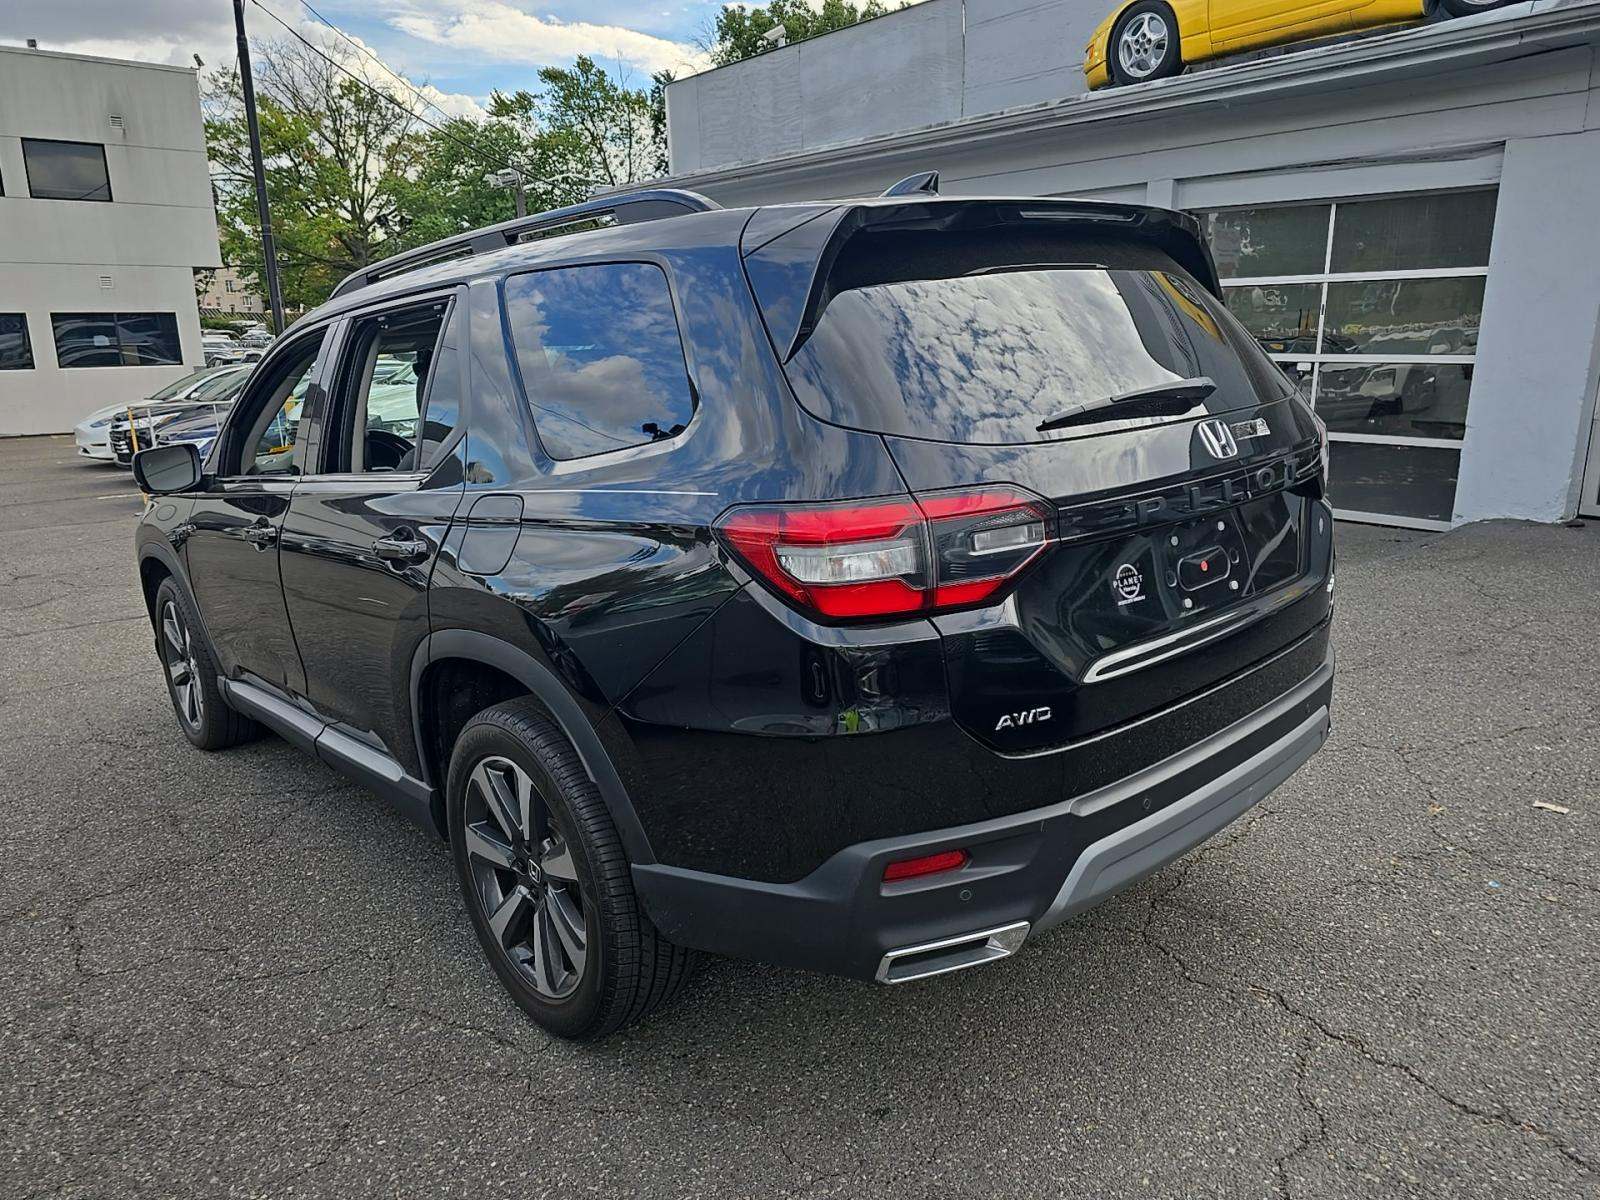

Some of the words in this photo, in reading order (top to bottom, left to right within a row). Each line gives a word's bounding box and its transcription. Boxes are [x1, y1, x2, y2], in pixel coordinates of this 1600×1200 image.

[1136, 457, 1300, 526] PILOT
[1112, 574, 1143, 589] PLANET
[995, 706, 1051, 731] AWD
